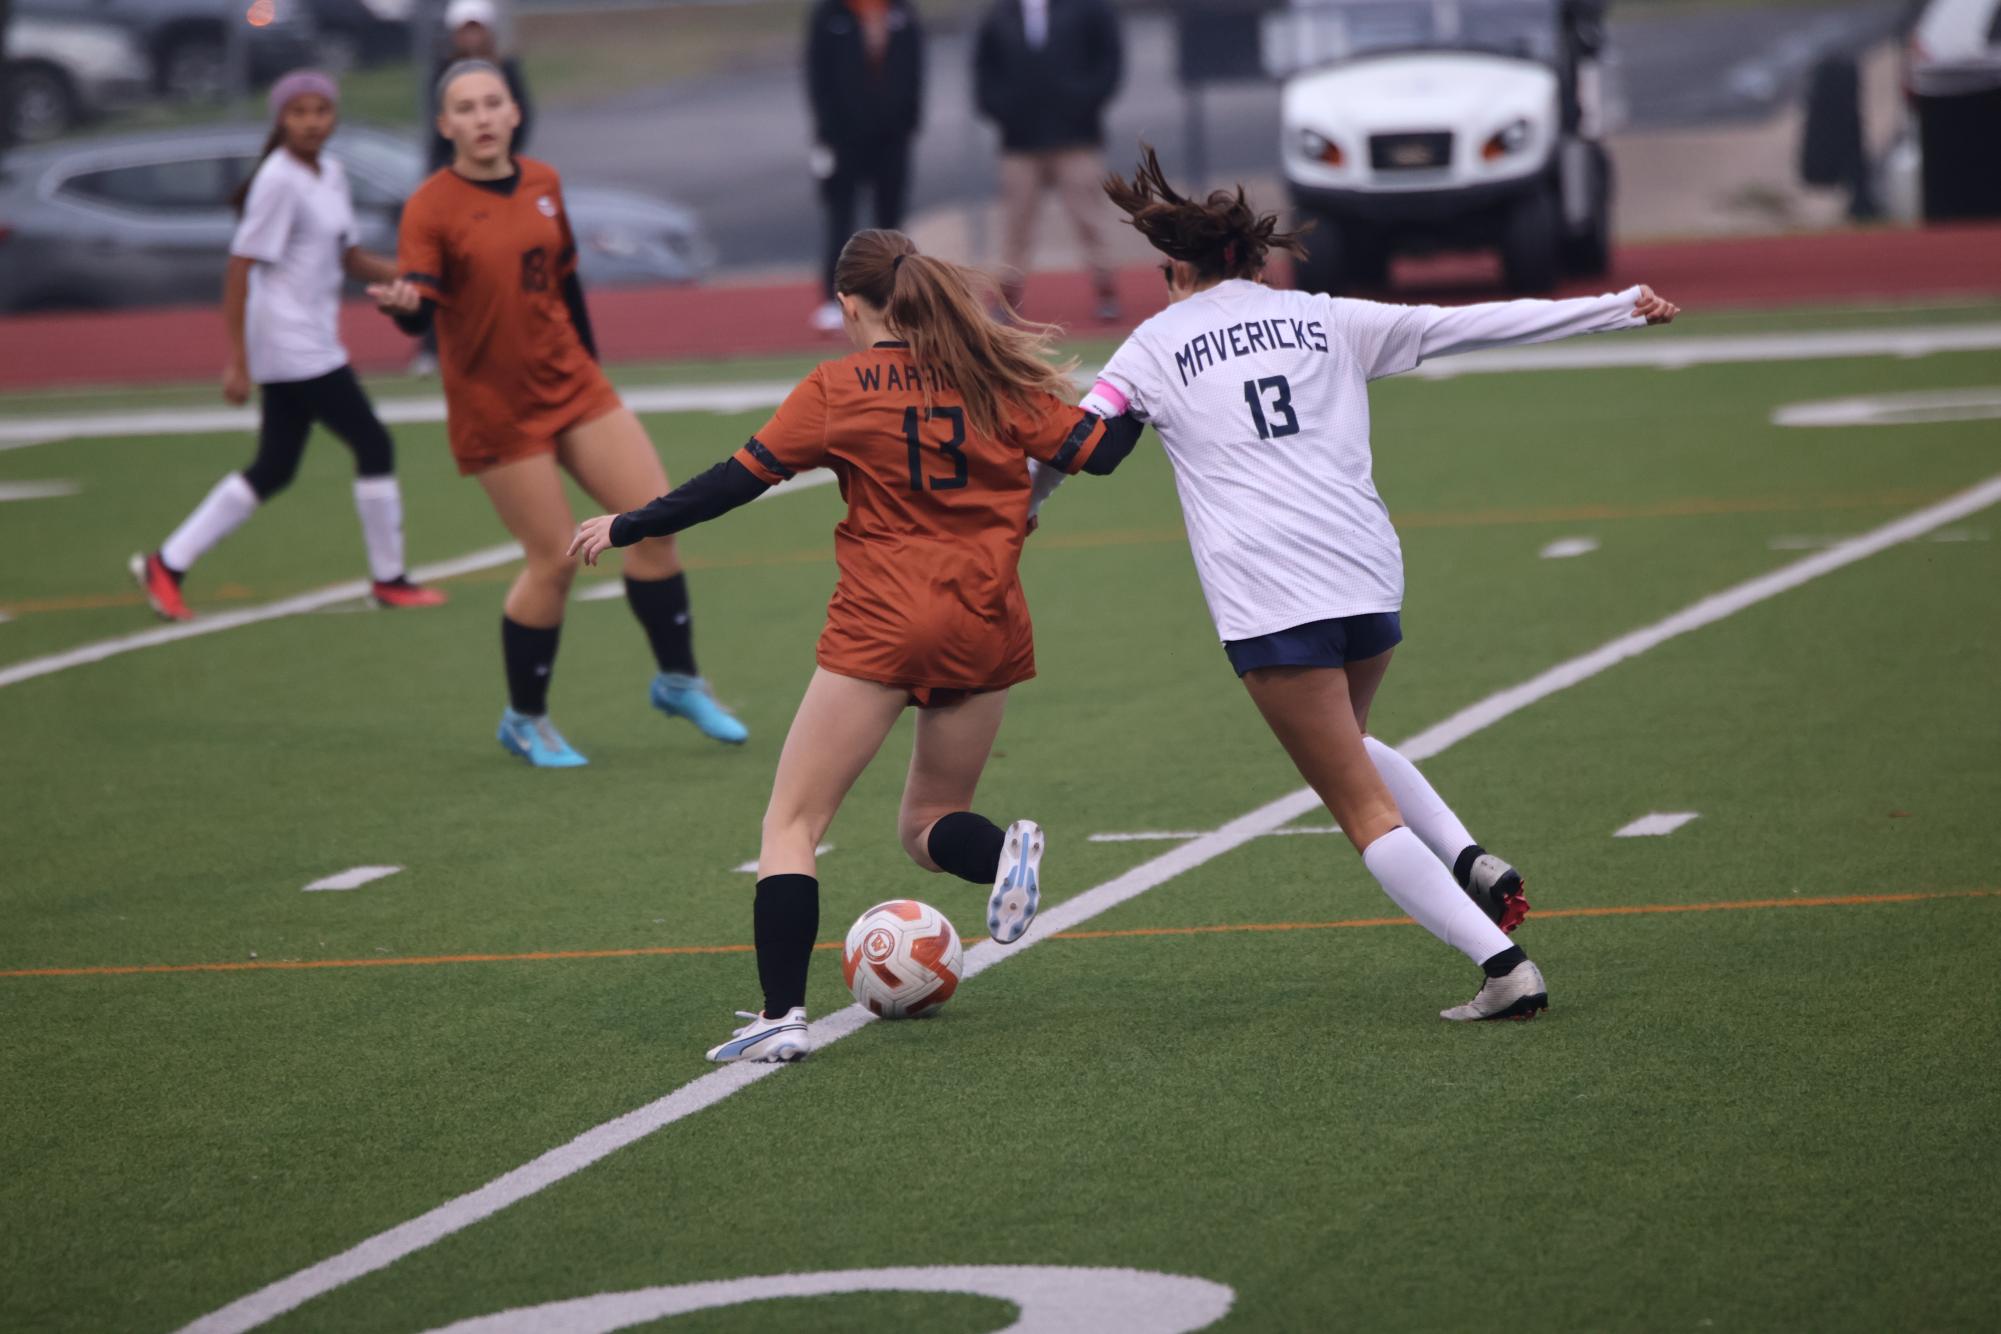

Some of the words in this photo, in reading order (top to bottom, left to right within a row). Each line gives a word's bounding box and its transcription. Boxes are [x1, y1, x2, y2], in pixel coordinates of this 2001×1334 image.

[1174, 318, 1329, 387] MAVERICKS
[1244, 374, 1300, 440] 13
[902, 406, 968, 491] 13
